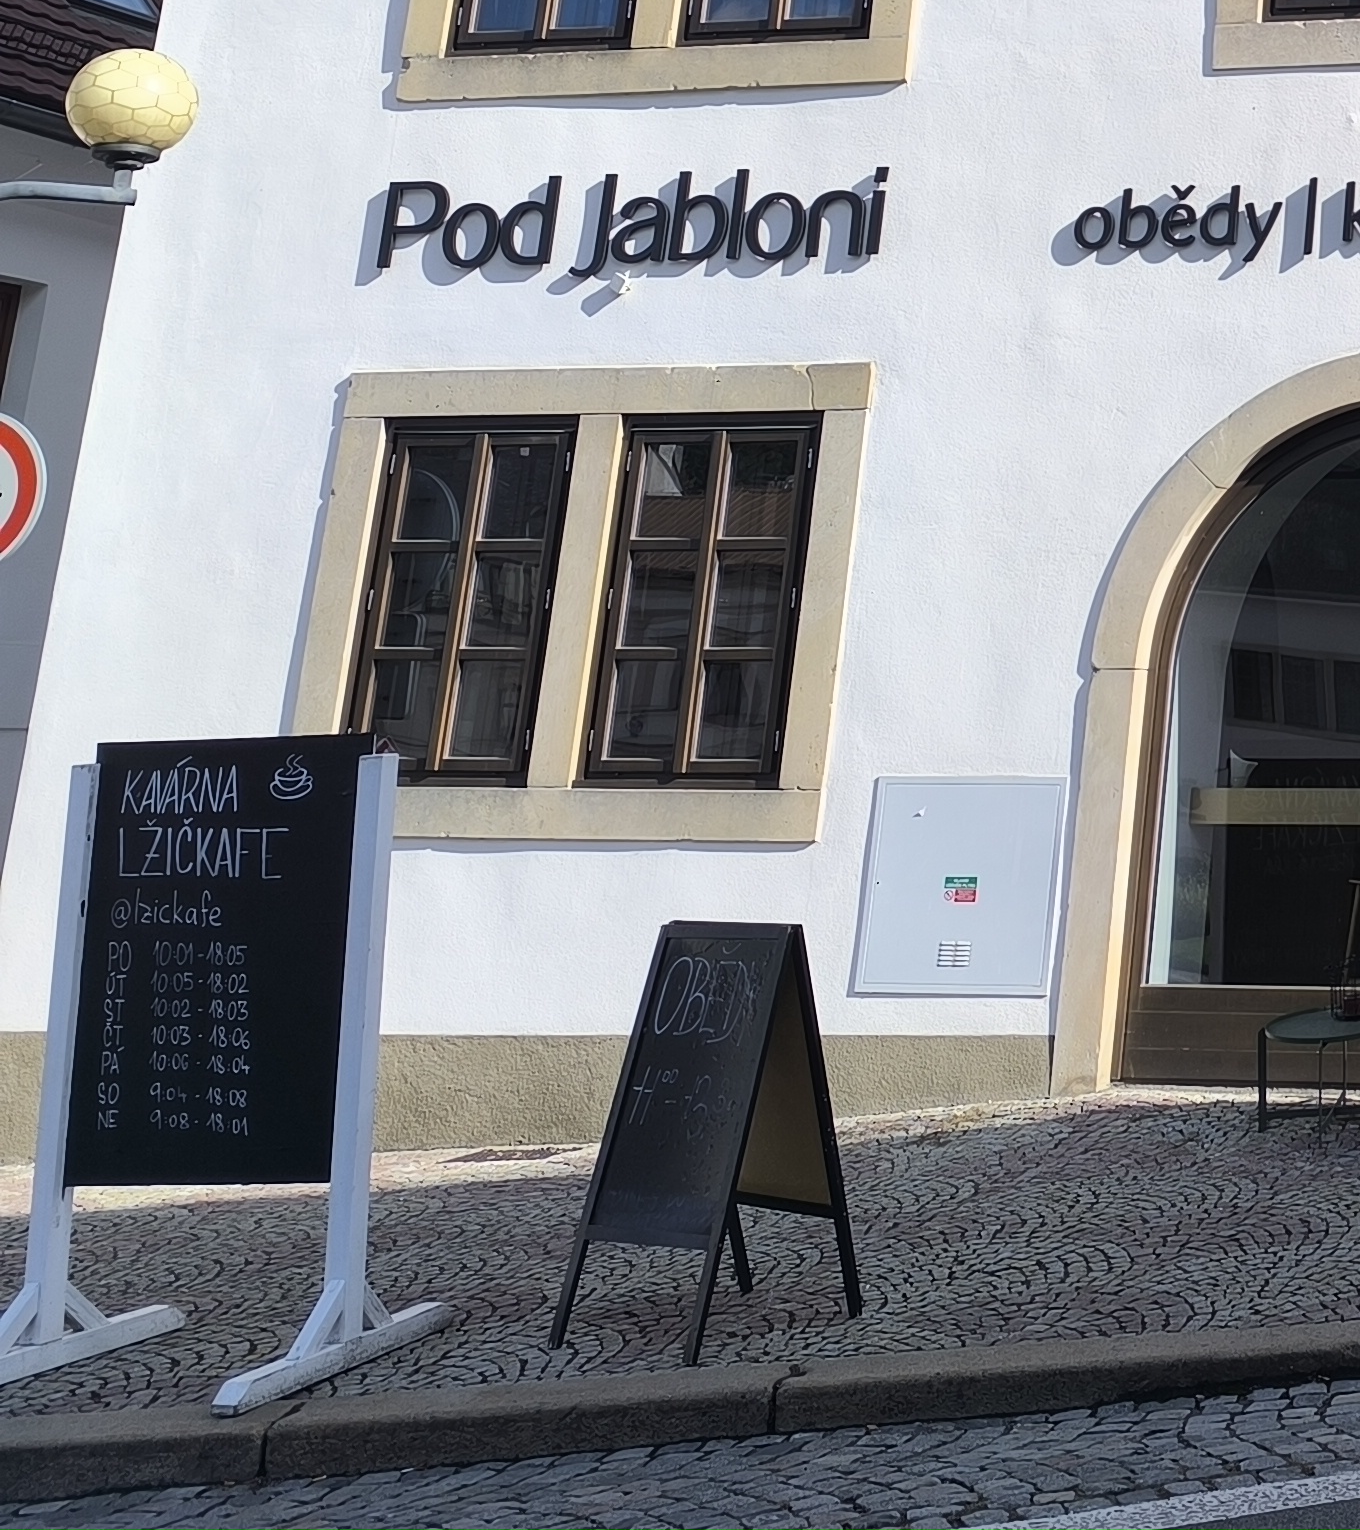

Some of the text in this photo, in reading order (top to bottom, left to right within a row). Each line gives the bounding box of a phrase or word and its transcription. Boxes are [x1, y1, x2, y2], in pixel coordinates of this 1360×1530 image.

[377, 175, 562, 269] Pod
[1073, 183, 1283, 263] obědy
[120, 756, 238, 815] KAVÁRNA
[118, 818, 289, 880] LŽIČKAFE
[111, 888, 222, 928] @lzickafe
[108, 940, 132, 972] PO
[106, 972, 127, 997] ÚT
[103, 999, 125, 1022] ST
[103, 1022, 124, 1047] ČT
[101, 1046, 125, 1076] PÁ
[97, 1082, 120, 1105] SO
[97, 1110, 119, 1130] NE
